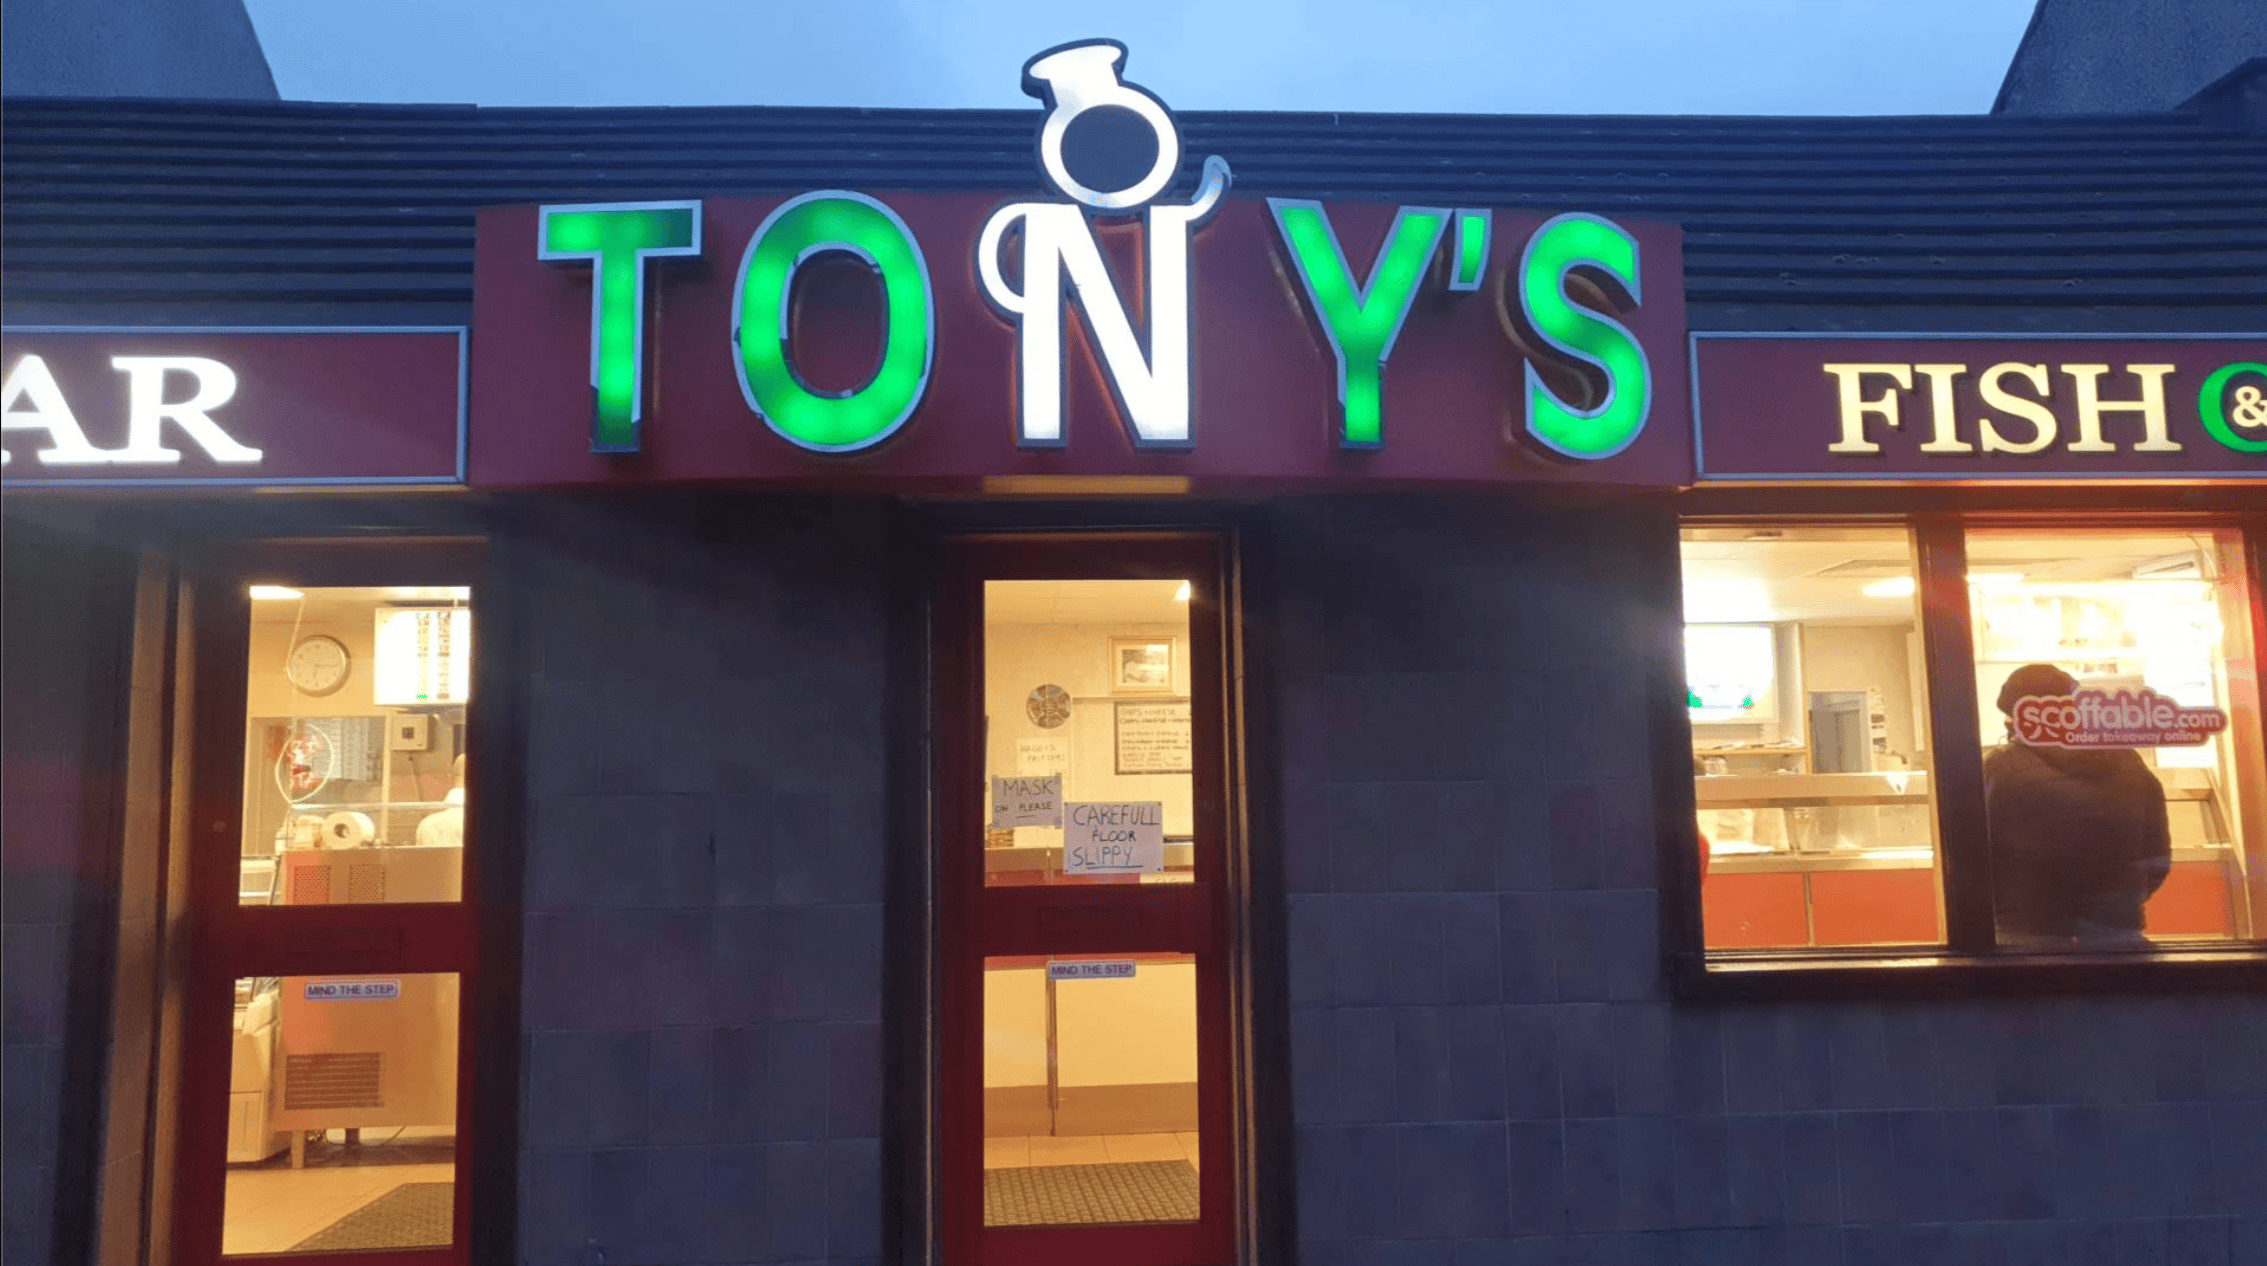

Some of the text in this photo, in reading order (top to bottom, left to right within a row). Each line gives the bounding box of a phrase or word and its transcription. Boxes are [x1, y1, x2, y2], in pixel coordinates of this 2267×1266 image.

[538, 188, 1652, 461] TONY'S
[1823, 361, 2183, 455] FISH
[2022, 695, 2221, 731] scoffable.com
[2065, 730, 2202, 744] Order takeaway online
[1002, 779, 1054, 797] MASK
[995, 801, 1053, 813] ON PLEASE
[1072, 804, 1160, 826] CAREFULL
[1091, 830, 1137, 843] FLOOR
[1071, 845, 1134, 867] SLIPPY
[1051, 963, 1133, 975] MIND THE STEP
[308, 983, 395, 996] MIND THE STEP
